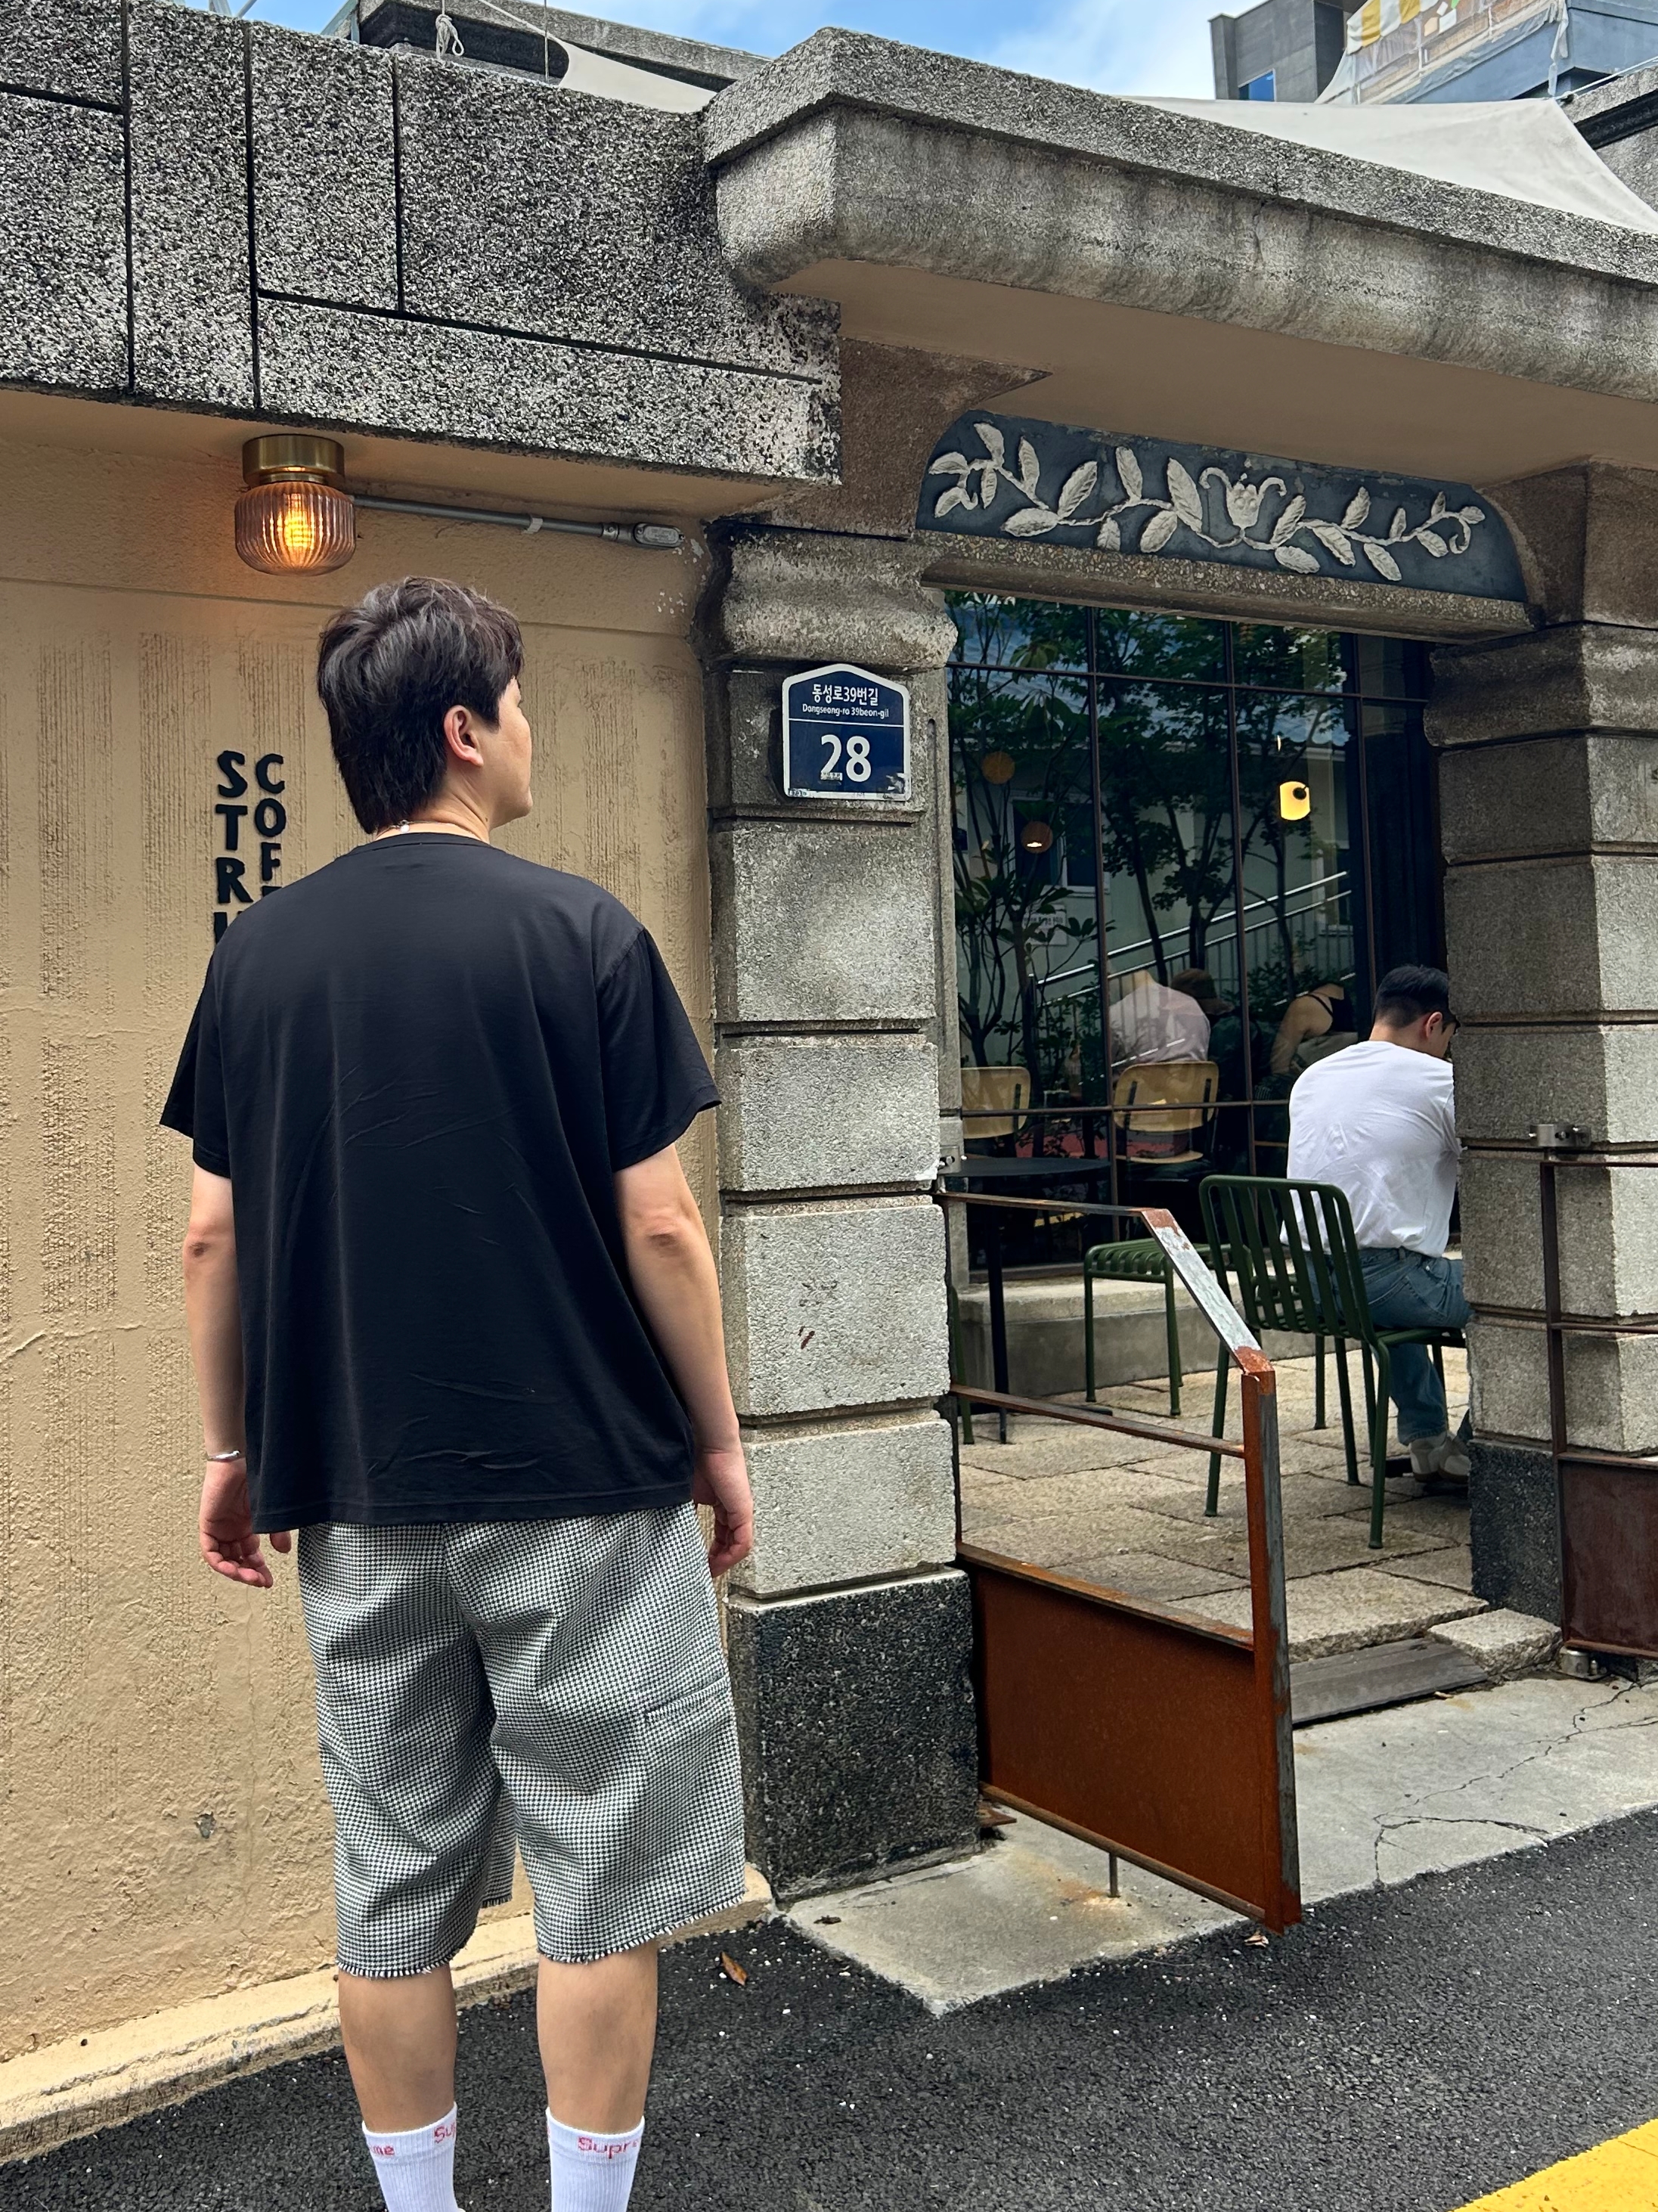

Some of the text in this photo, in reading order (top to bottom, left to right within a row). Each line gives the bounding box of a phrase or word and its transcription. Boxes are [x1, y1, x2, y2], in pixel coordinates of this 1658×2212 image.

[812, 684, 879, 706] 동성로39번길
[802, 703, 889, 720] Dongseong-ro 39beon-gil
[820, 734, 871, 782] 28
[255, 753, 287, 898] COF
[434, 2121, 456, 2143] Su
